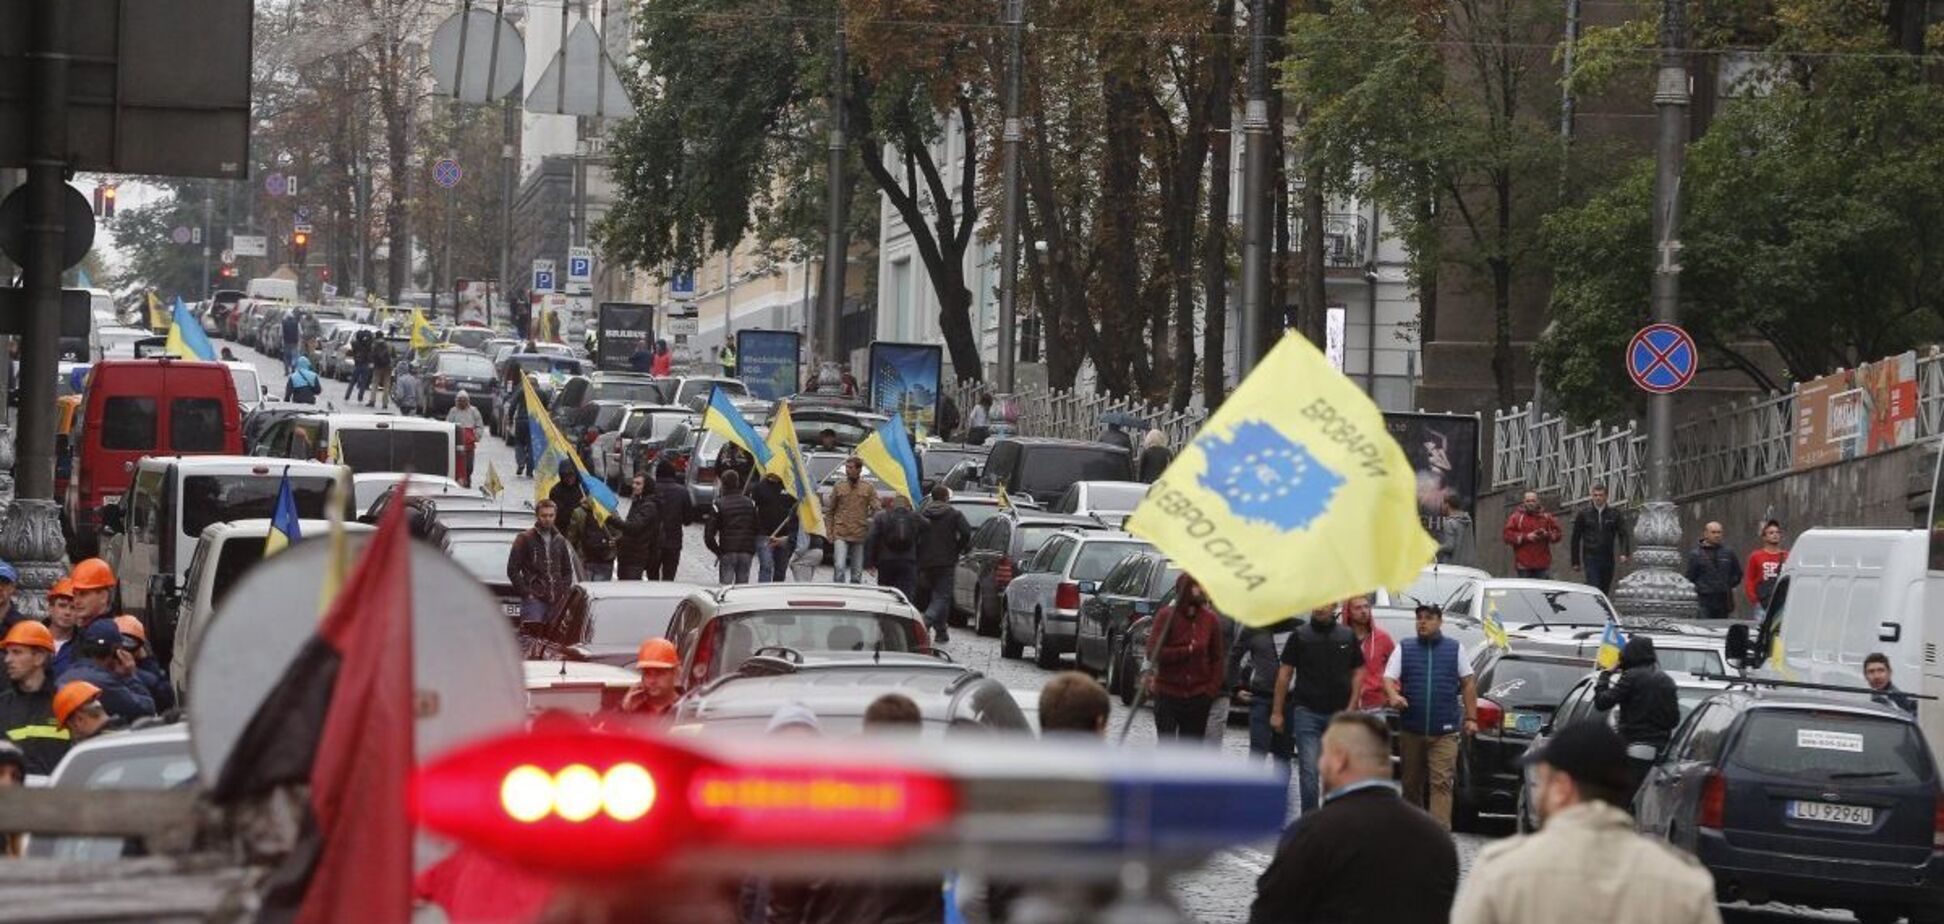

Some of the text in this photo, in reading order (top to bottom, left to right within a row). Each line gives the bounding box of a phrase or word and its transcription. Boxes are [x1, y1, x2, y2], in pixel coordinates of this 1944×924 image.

[1300, 397, 1389, 478] БРОВАРИ
[1204, 537, 1268, 592] СИЛА
[1798, 801, 1872, 824] LU 9296U
